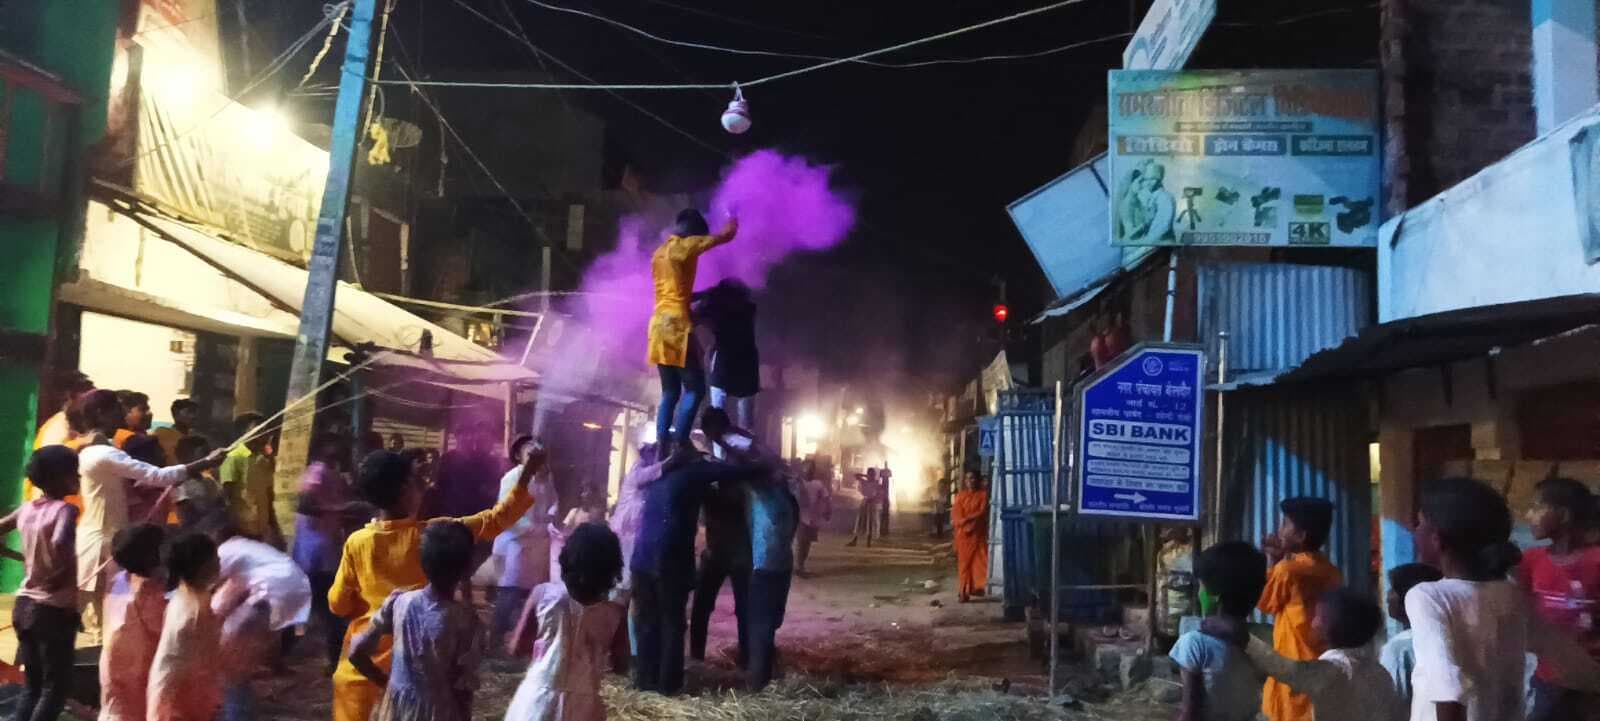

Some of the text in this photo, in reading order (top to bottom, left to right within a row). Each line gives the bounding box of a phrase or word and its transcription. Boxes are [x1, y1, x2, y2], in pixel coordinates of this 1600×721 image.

[1291, 223, 1328, 240] 4K
[1135, 380, 1163, 396] पंचायत
[1093, 422, 1188, 442] SBI BANK
